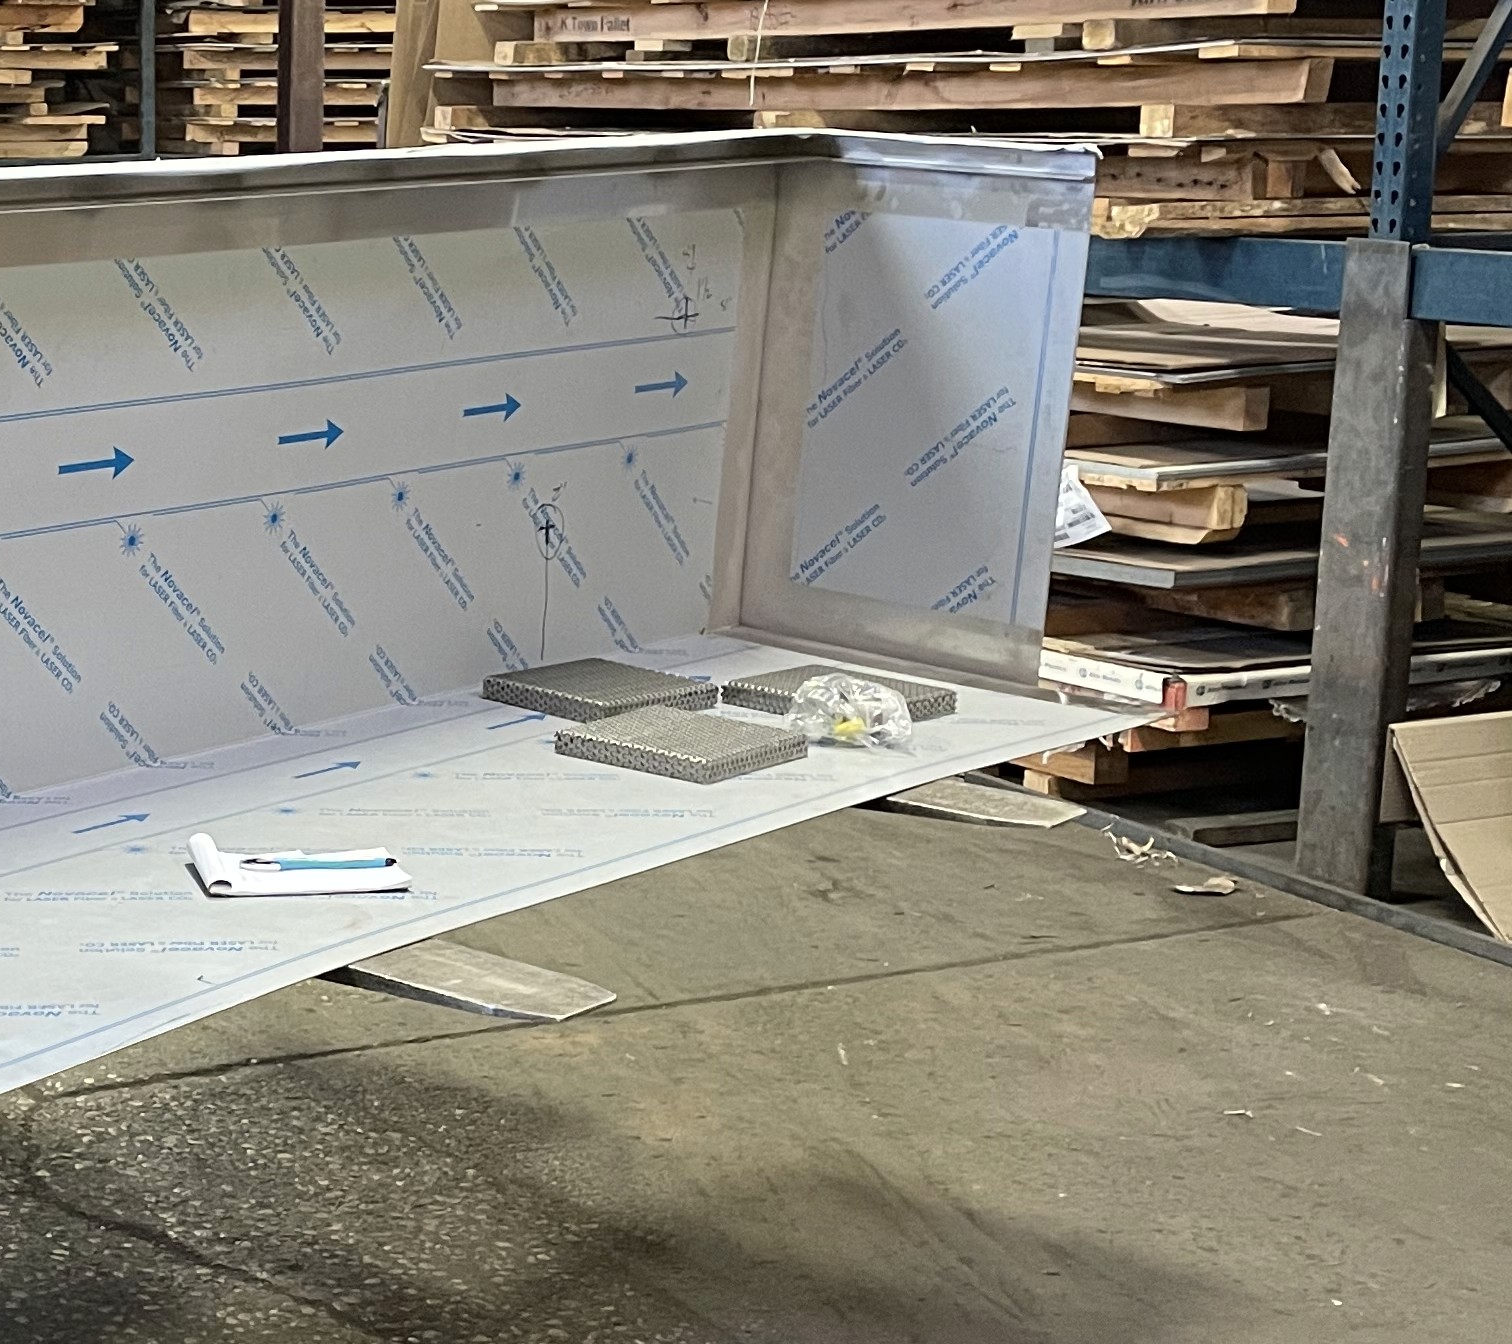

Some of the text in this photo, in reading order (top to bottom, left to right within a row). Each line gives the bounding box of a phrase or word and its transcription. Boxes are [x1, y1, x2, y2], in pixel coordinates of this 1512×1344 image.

[17, 627, 37, 649] Fiber
[40, 652, 62, 679] LASER
[51, 644, 81, 683] Solution
